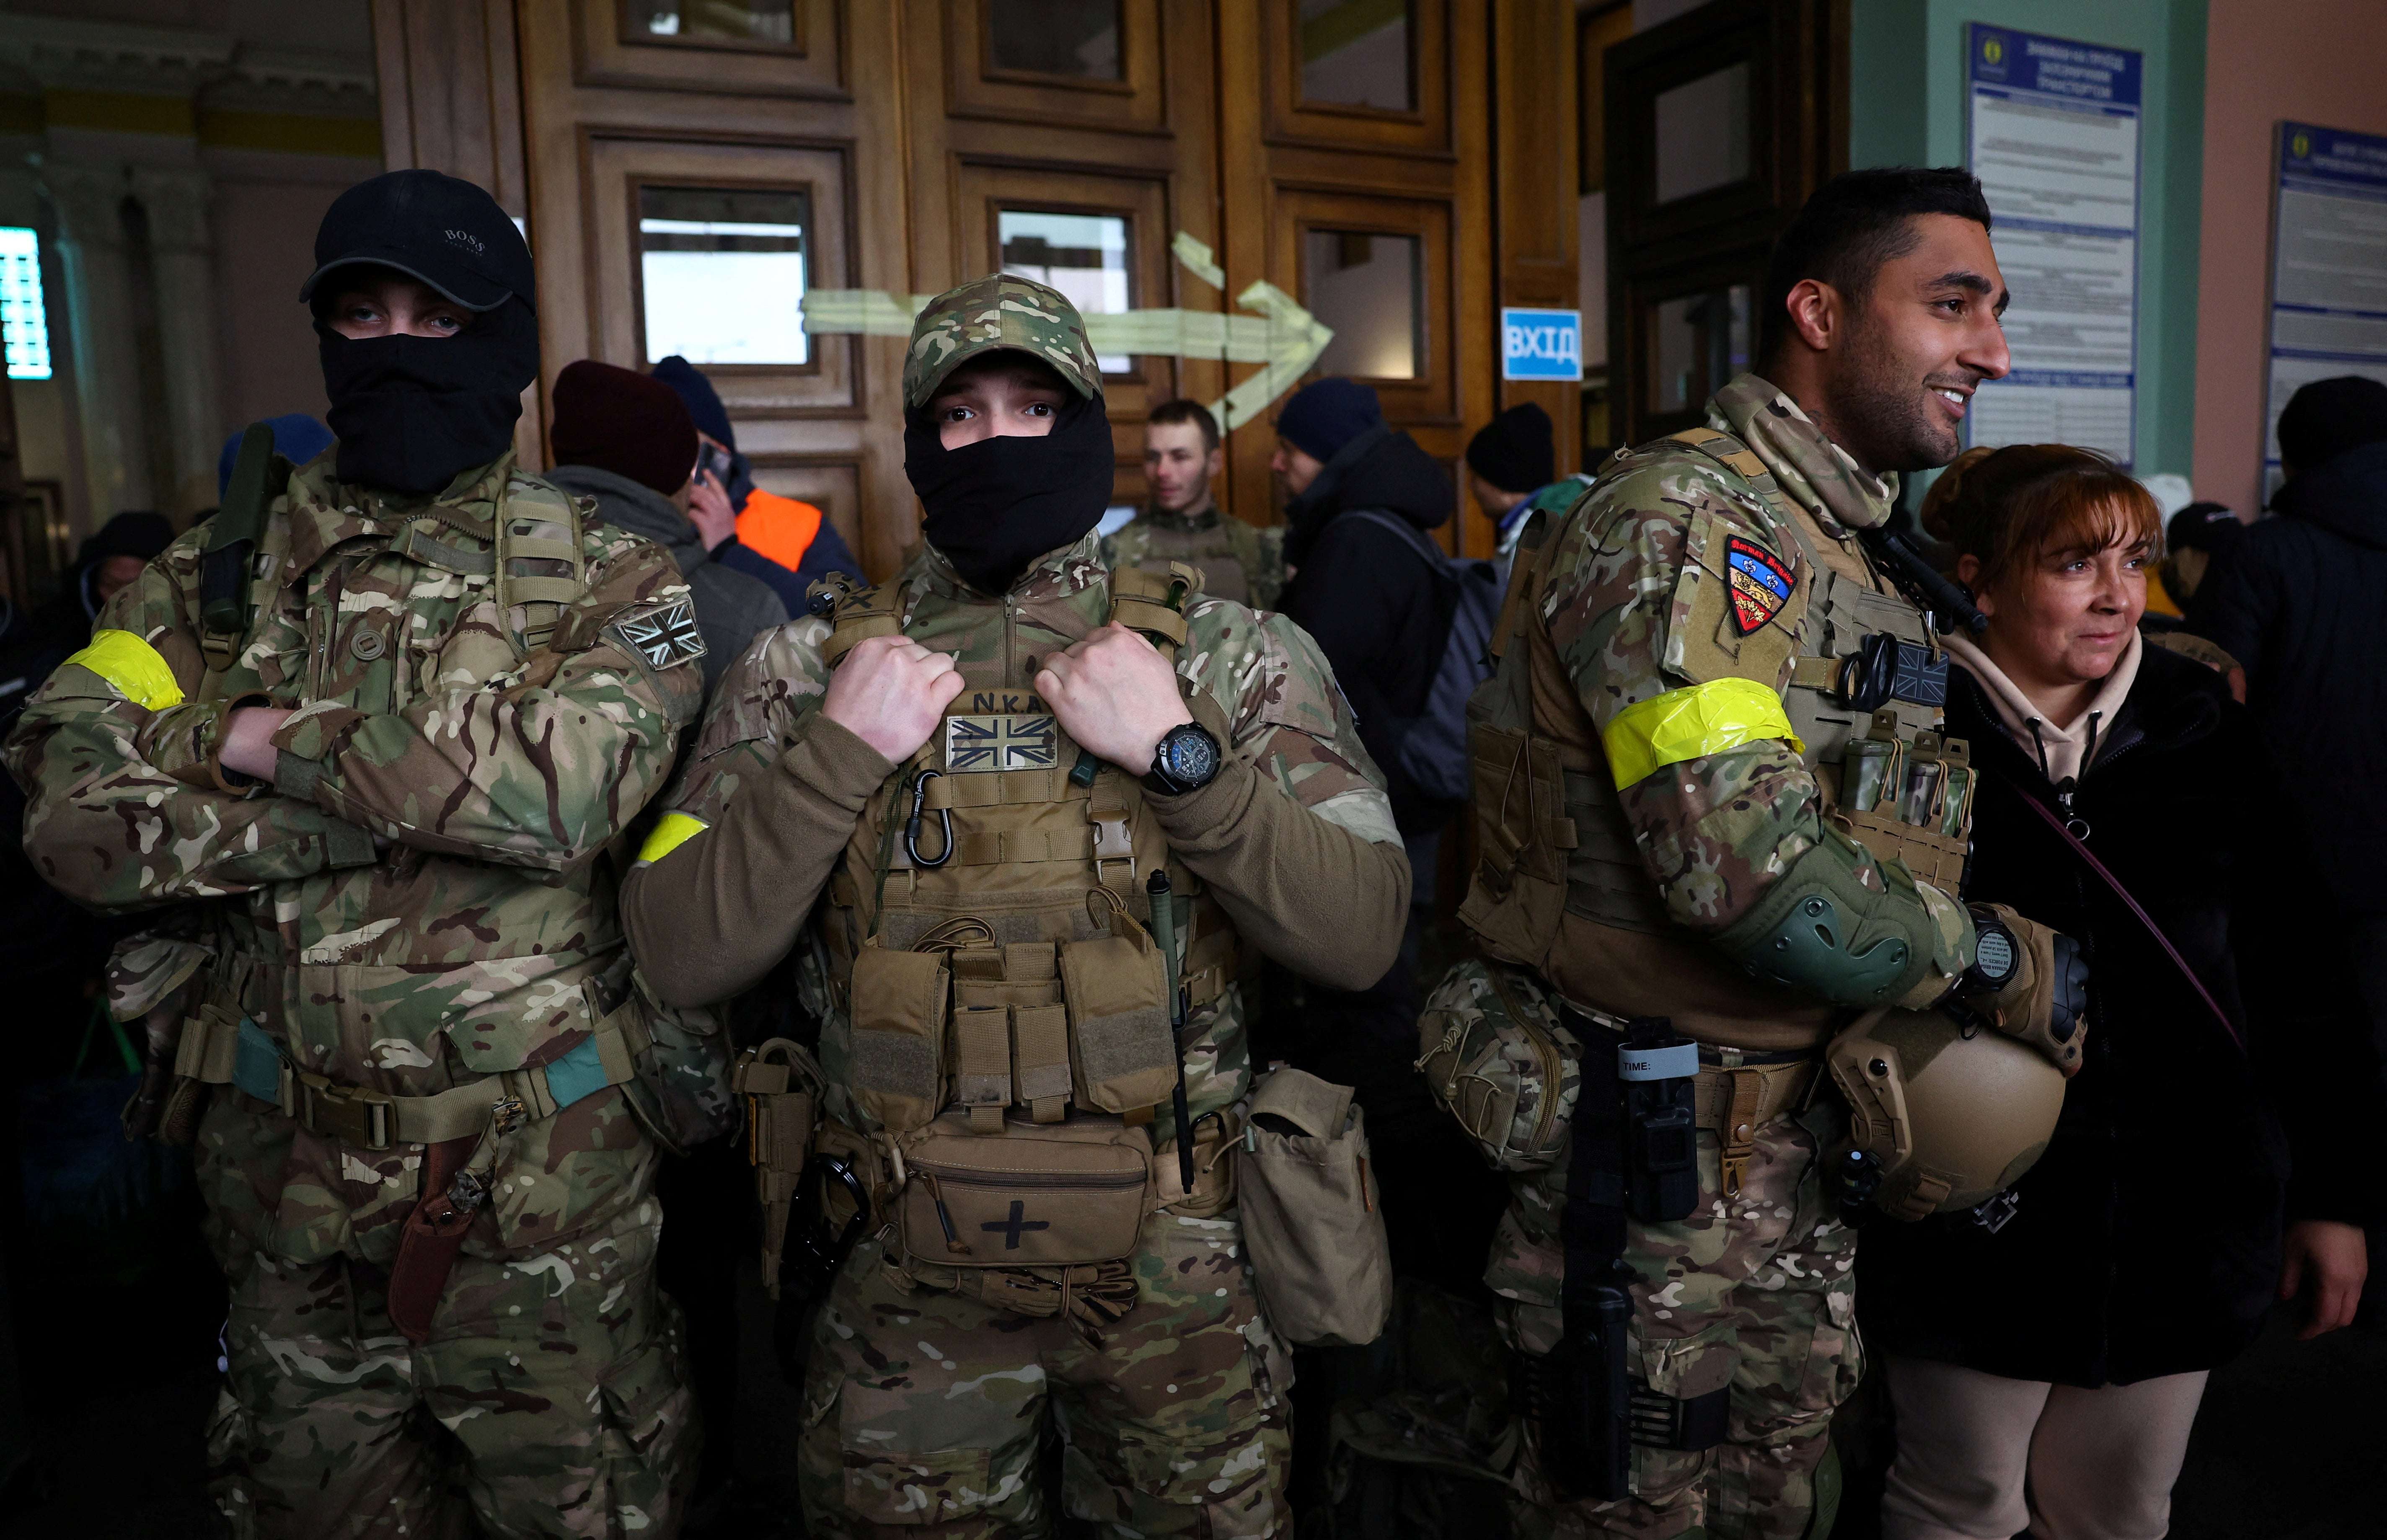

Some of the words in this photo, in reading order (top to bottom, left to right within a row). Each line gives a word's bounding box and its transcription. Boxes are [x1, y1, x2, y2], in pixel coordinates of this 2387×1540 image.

[445, 230, 485, 251] BOSS
[1507, 325, 1577, 364] ВХІД
[1730, 539, 1765, 560] Norman
[1182, 765, 1191, 775] 14:50
[1623, 1062, 1651, 1071] TIME:
